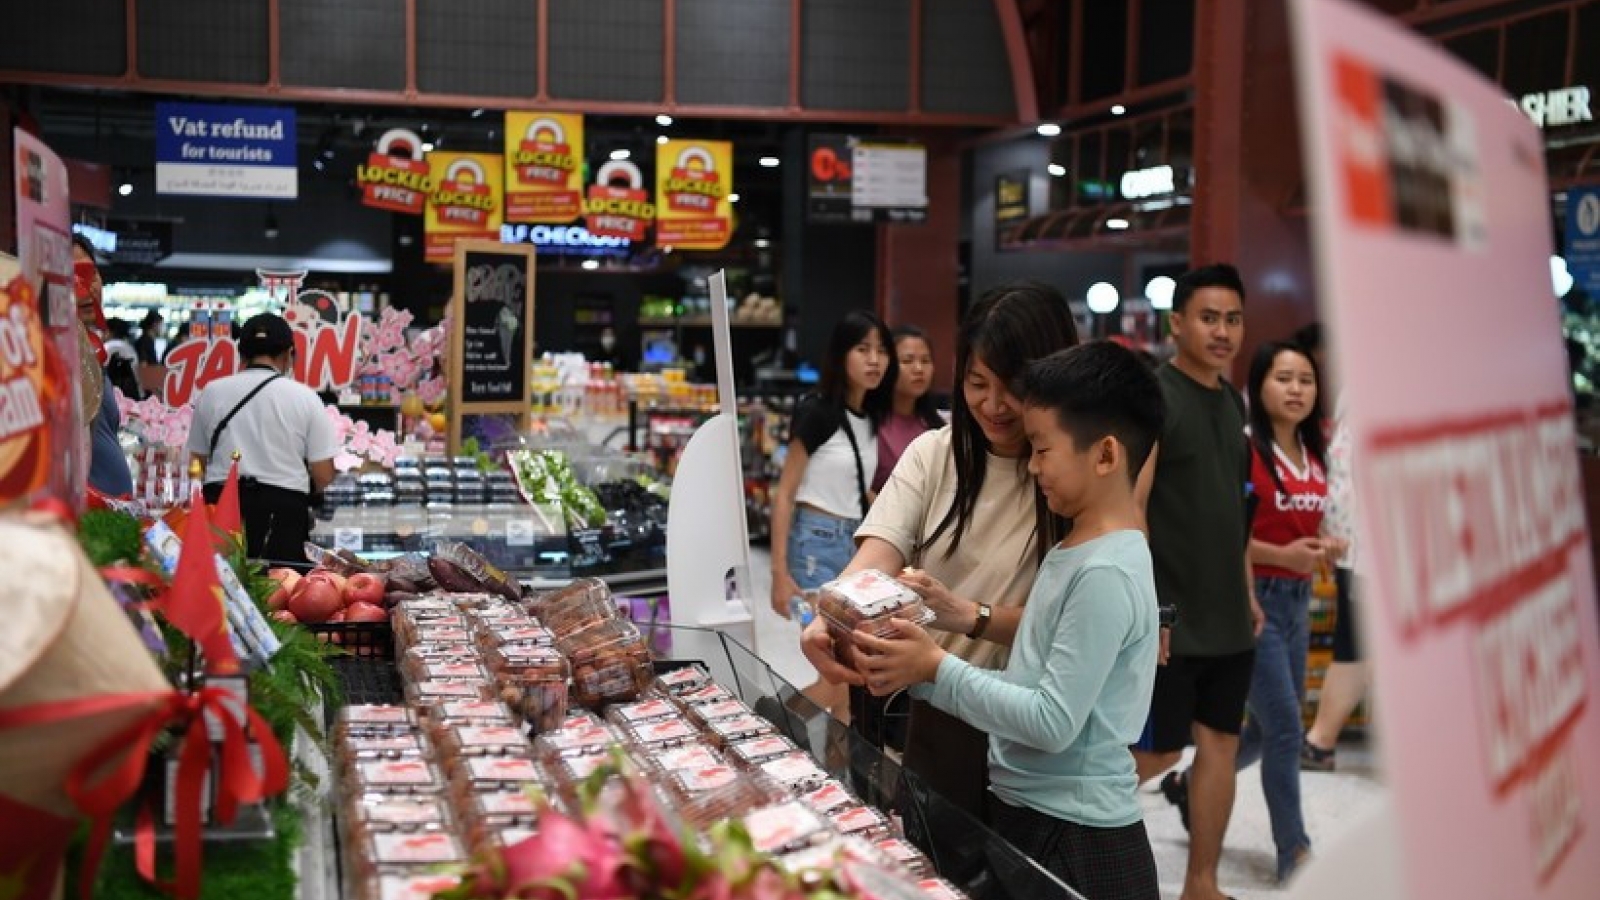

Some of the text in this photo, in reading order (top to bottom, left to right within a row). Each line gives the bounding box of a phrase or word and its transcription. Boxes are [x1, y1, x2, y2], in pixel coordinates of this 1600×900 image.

[168, 115, 284, 140] Vat refund
[181, 142, 273, 162] for tourists
[514, 149, 574, 170] LOCKED
[356, 163, 432, 192] LOCKED
[526, 167, 560, 182] PRICE
[373, 185, 415, 205] PRICE
[663, 178, 722, 198] LOCKED
[432, 189, 494, 211] LOCKED
[581, 198, 655, 219] LOCKED
[675, 192, 709, 208] PRICE
[444, 205, 481, 222] PRICE
[596, 215, 636, 233] PRICE
[164, 312, 360, 410] JAN
